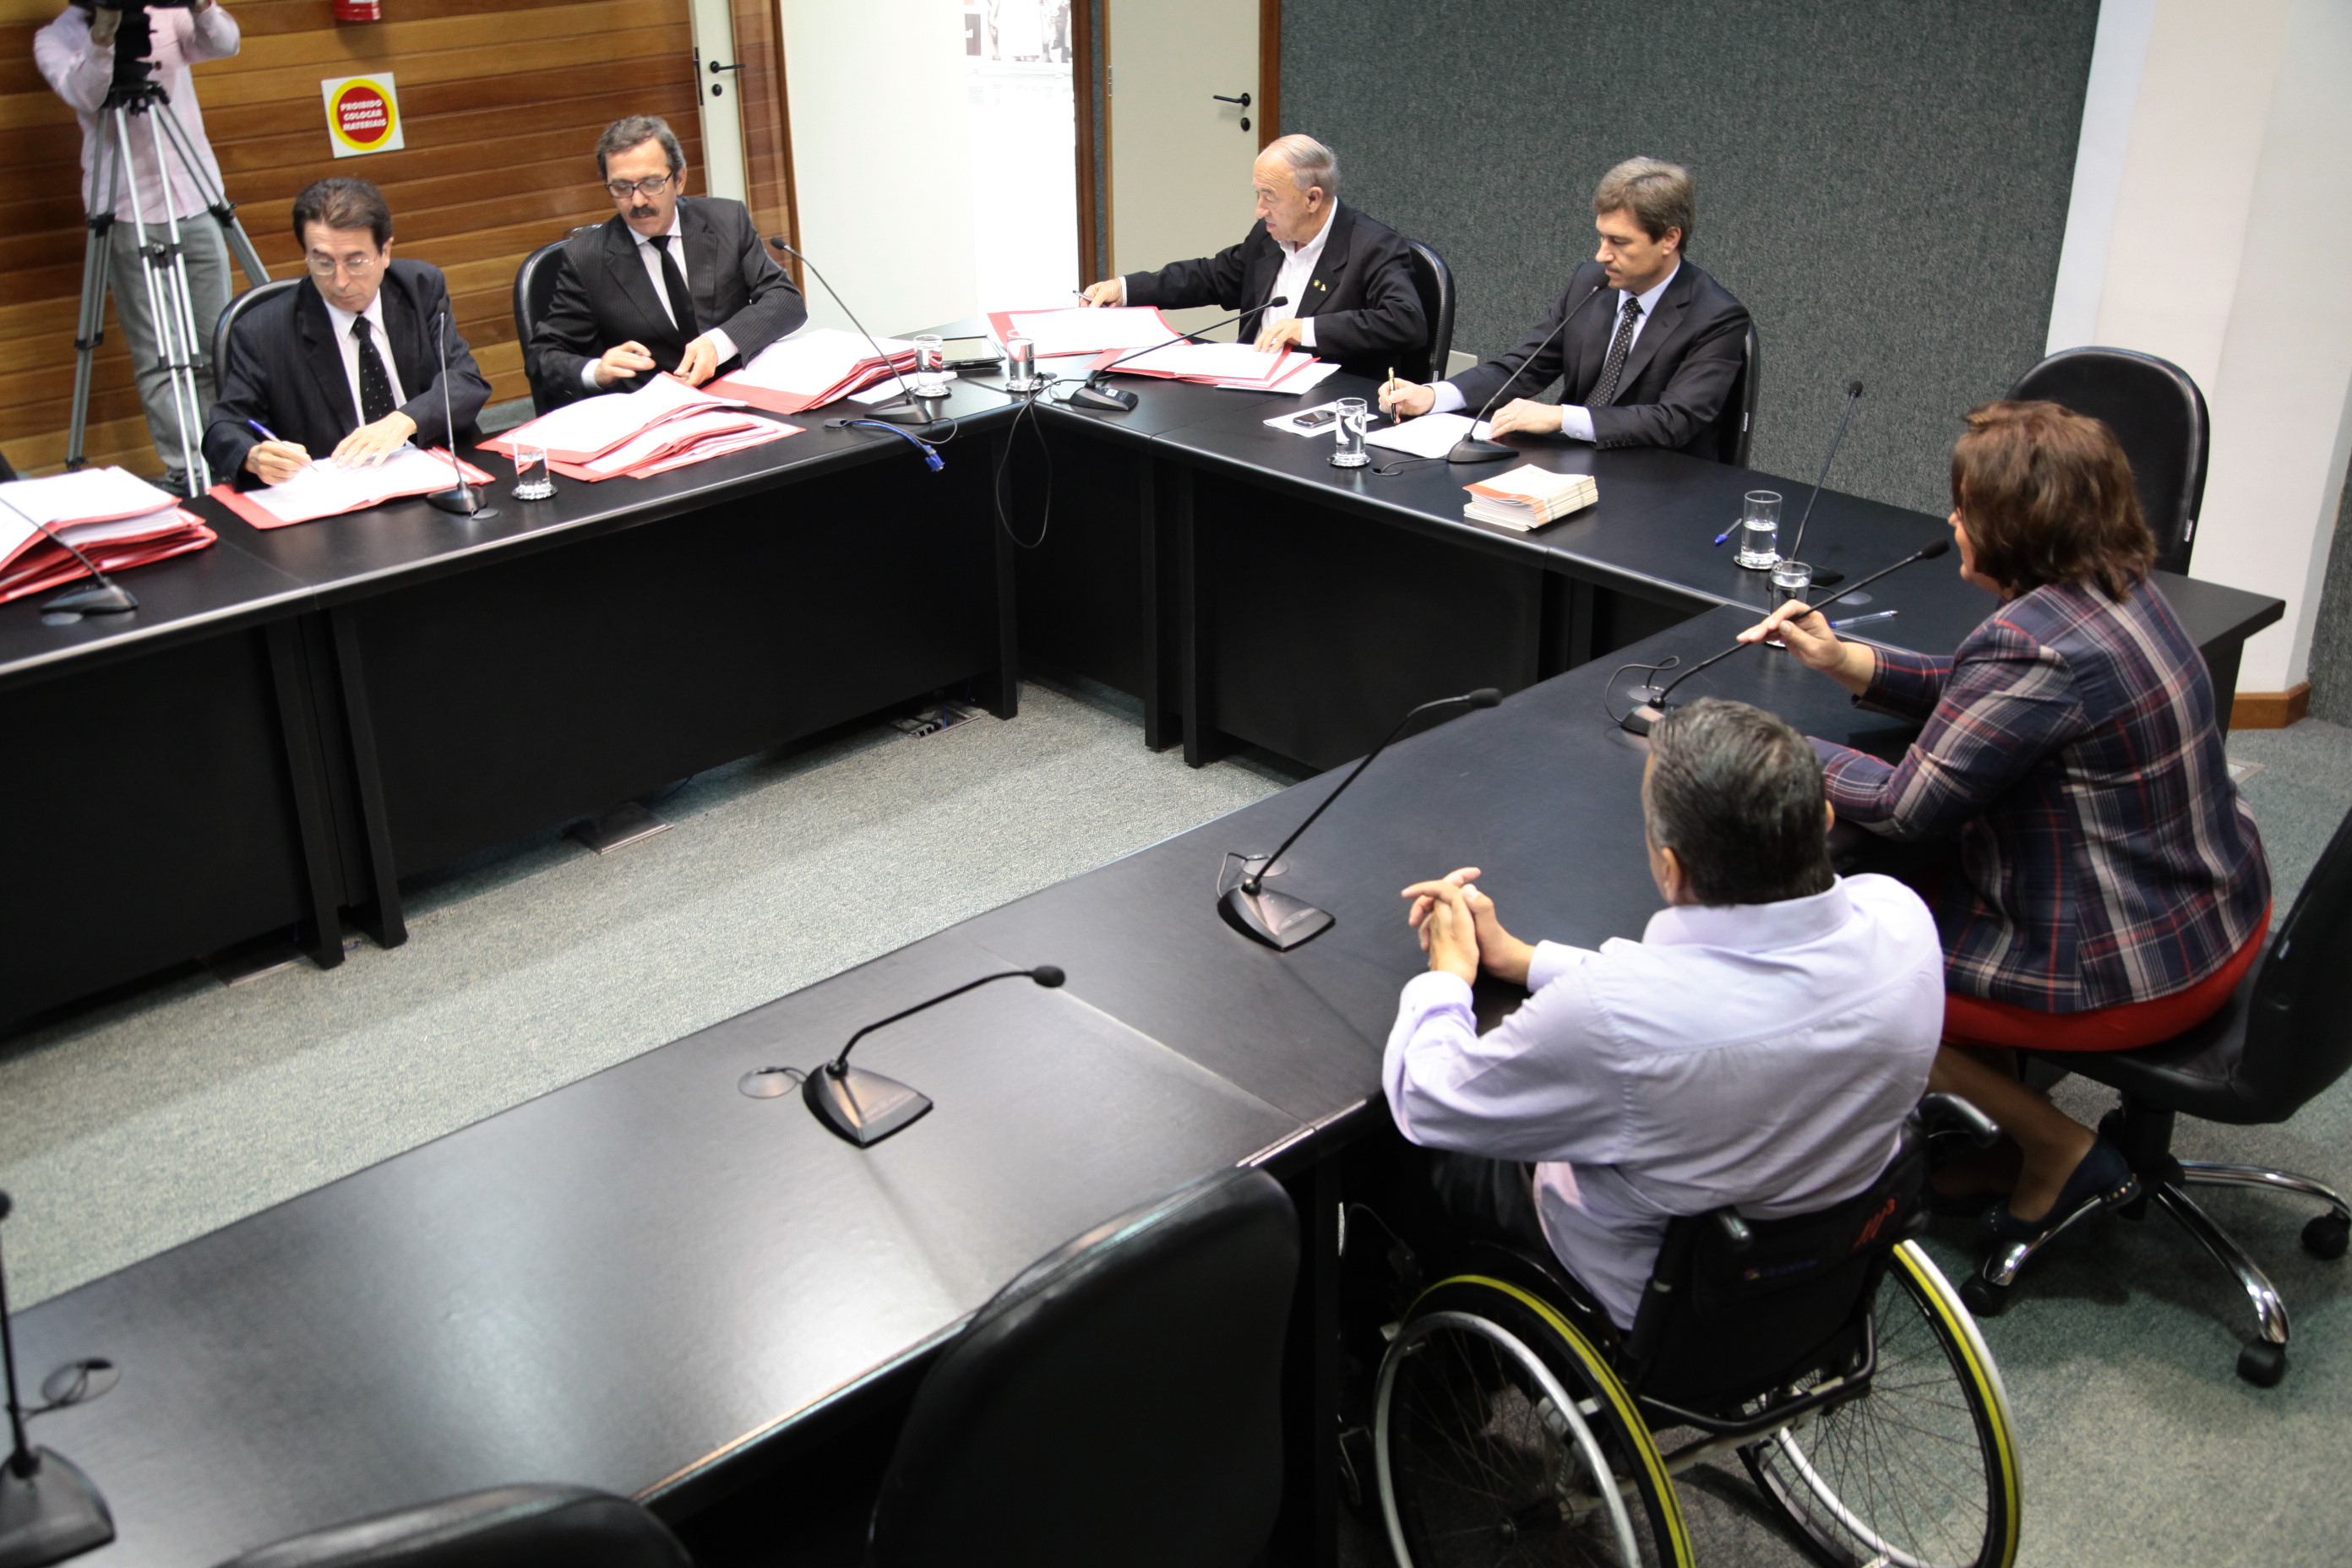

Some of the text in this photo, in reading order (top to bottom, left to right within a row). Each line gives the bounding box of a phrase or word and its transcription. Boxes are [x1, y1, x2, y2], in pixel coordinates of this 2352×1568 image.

[340, 99, 383, 112] PROIBIDO
[344, 109, 383, 121] COLOCAR
[343, 118, 387, 131] MATERIAIS
